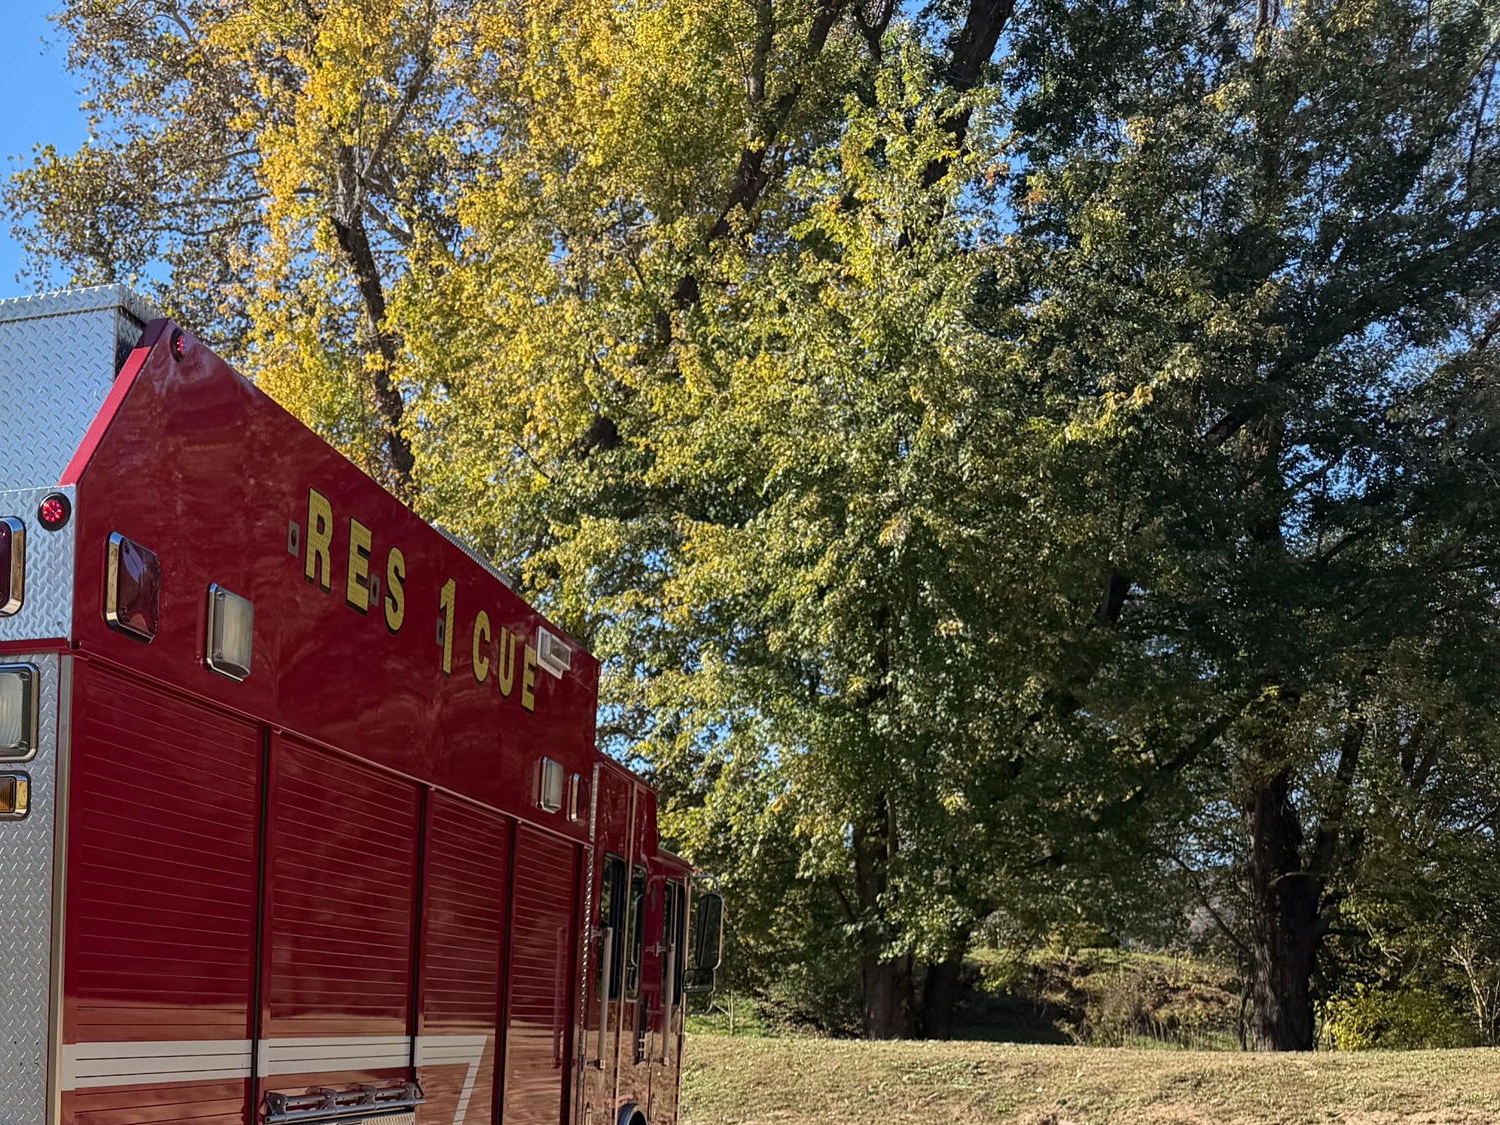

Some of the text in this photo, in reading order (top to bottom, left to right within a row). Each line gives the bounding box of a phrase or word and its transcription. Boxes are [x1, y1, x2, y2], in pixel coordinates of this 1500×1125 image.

[303, 485, 537, 714] RES 1 CUE
